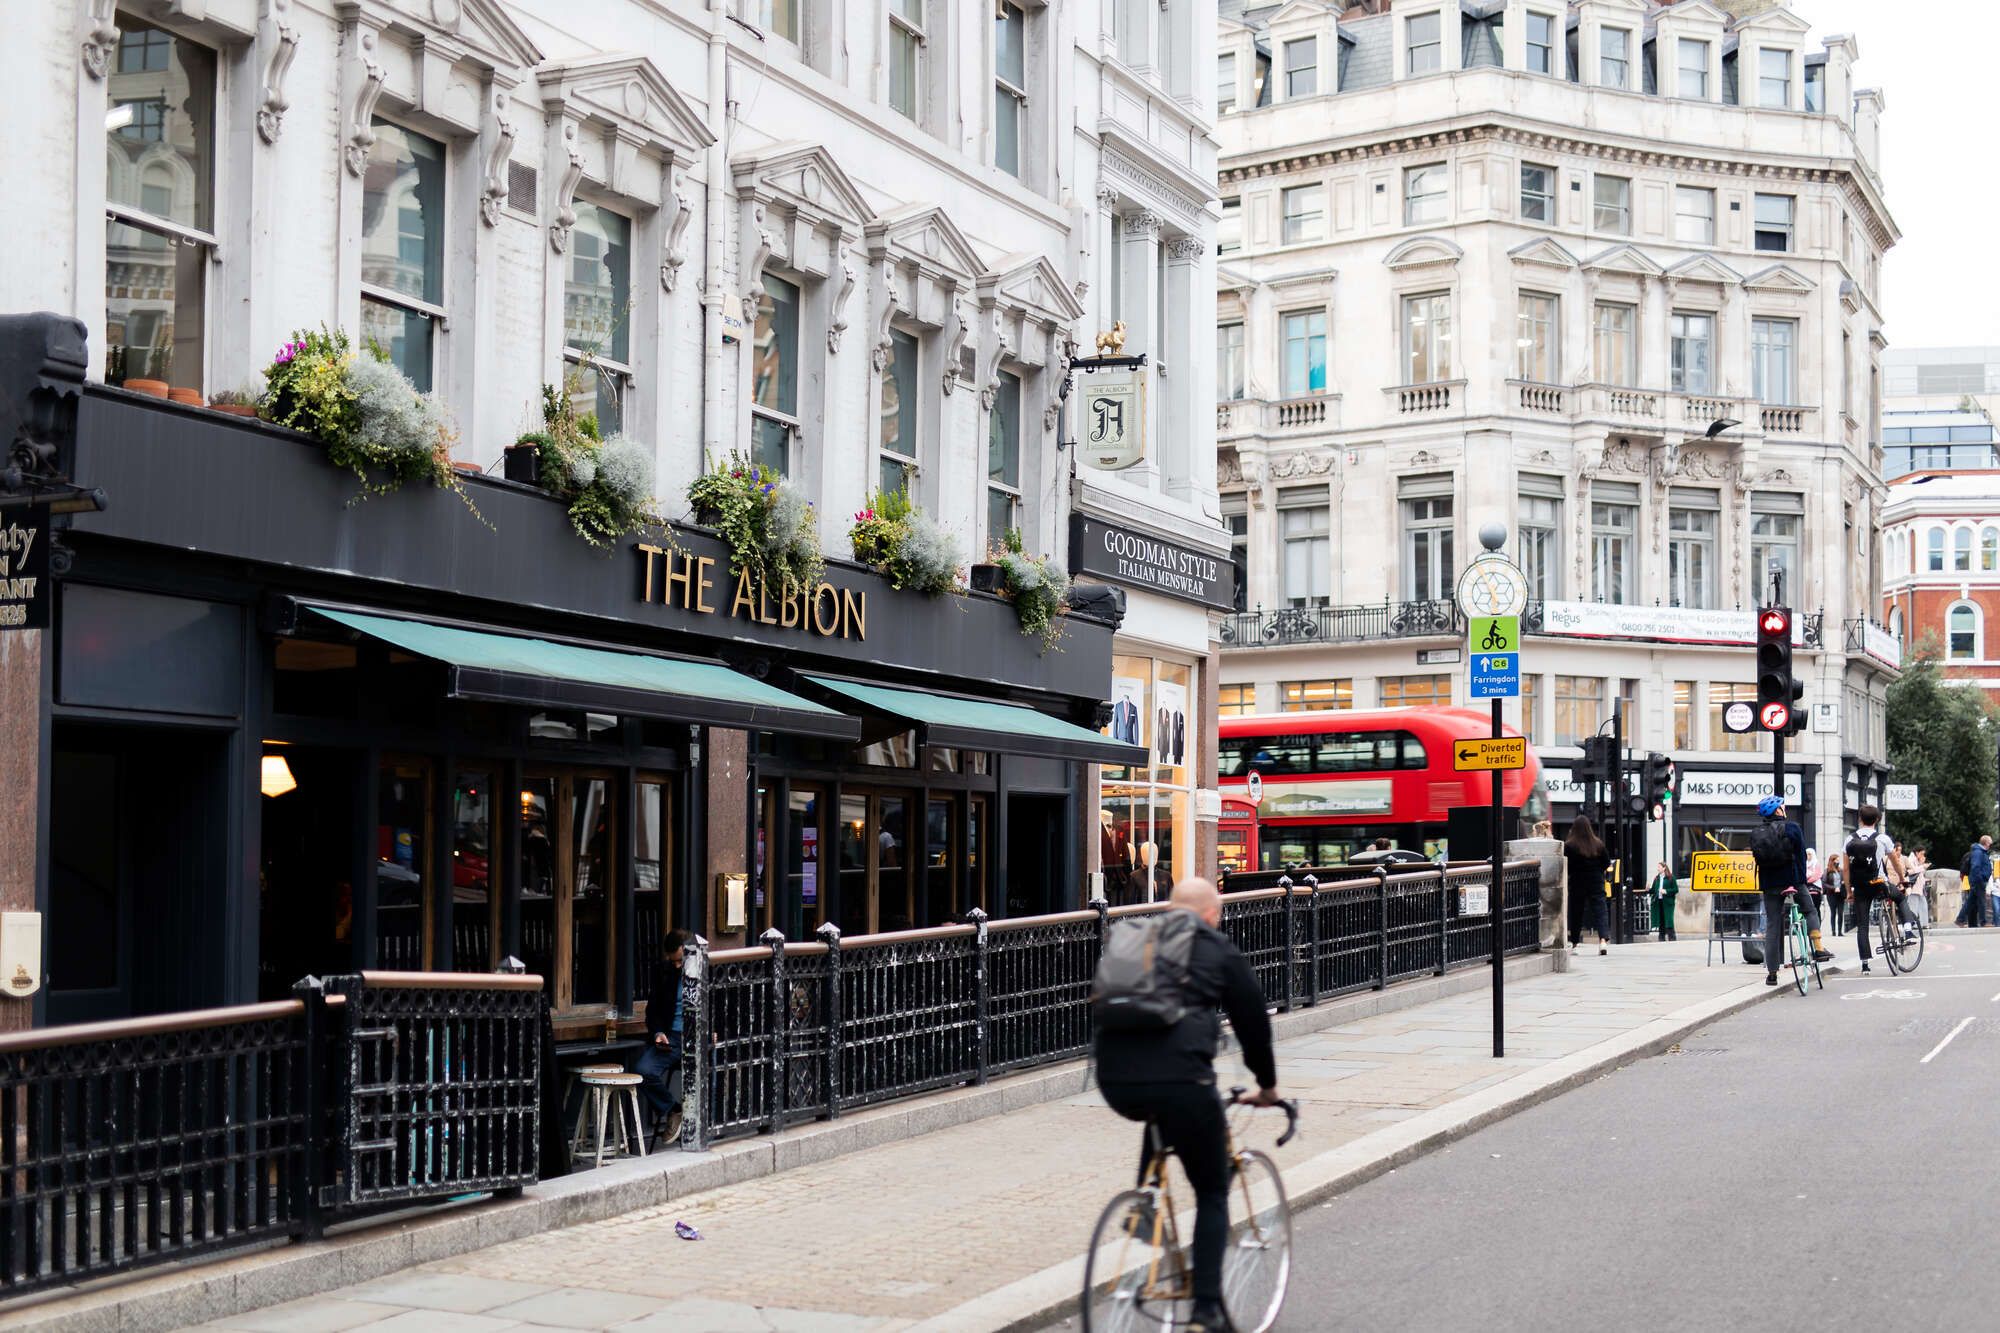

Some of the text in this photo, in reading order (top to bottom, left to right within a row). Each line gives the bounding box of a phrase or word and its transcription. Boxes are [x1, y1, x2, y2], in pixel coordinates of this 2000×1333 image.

[1084, 523, 1089, 533] 4
[1104, 530, 1217, 582] GOODMAN STYLE
[1118, 559, 1204, 596] ITALIAN MENSWEAR
[638, 543, 866, 641] THE ALBION
[1552, 610, 1581, 628] Regus
[1473, 676, 1516, 684] Farringdon
[1489, 686, 1507, 694] mins
[1480, 742, 1522, 753] Diverted
[1486, 755, 1516, 764] traffic
[1687, 783, 1713, 794] M&S
[1718, 783, 1754, 795] FOOD
[1756, 784, 1774, 795] TO
[1890, 790, 1914, 800] M&S
[1697, 860, 1754, 871] Diverted
[1704, 873, 1745, 884] traffic
